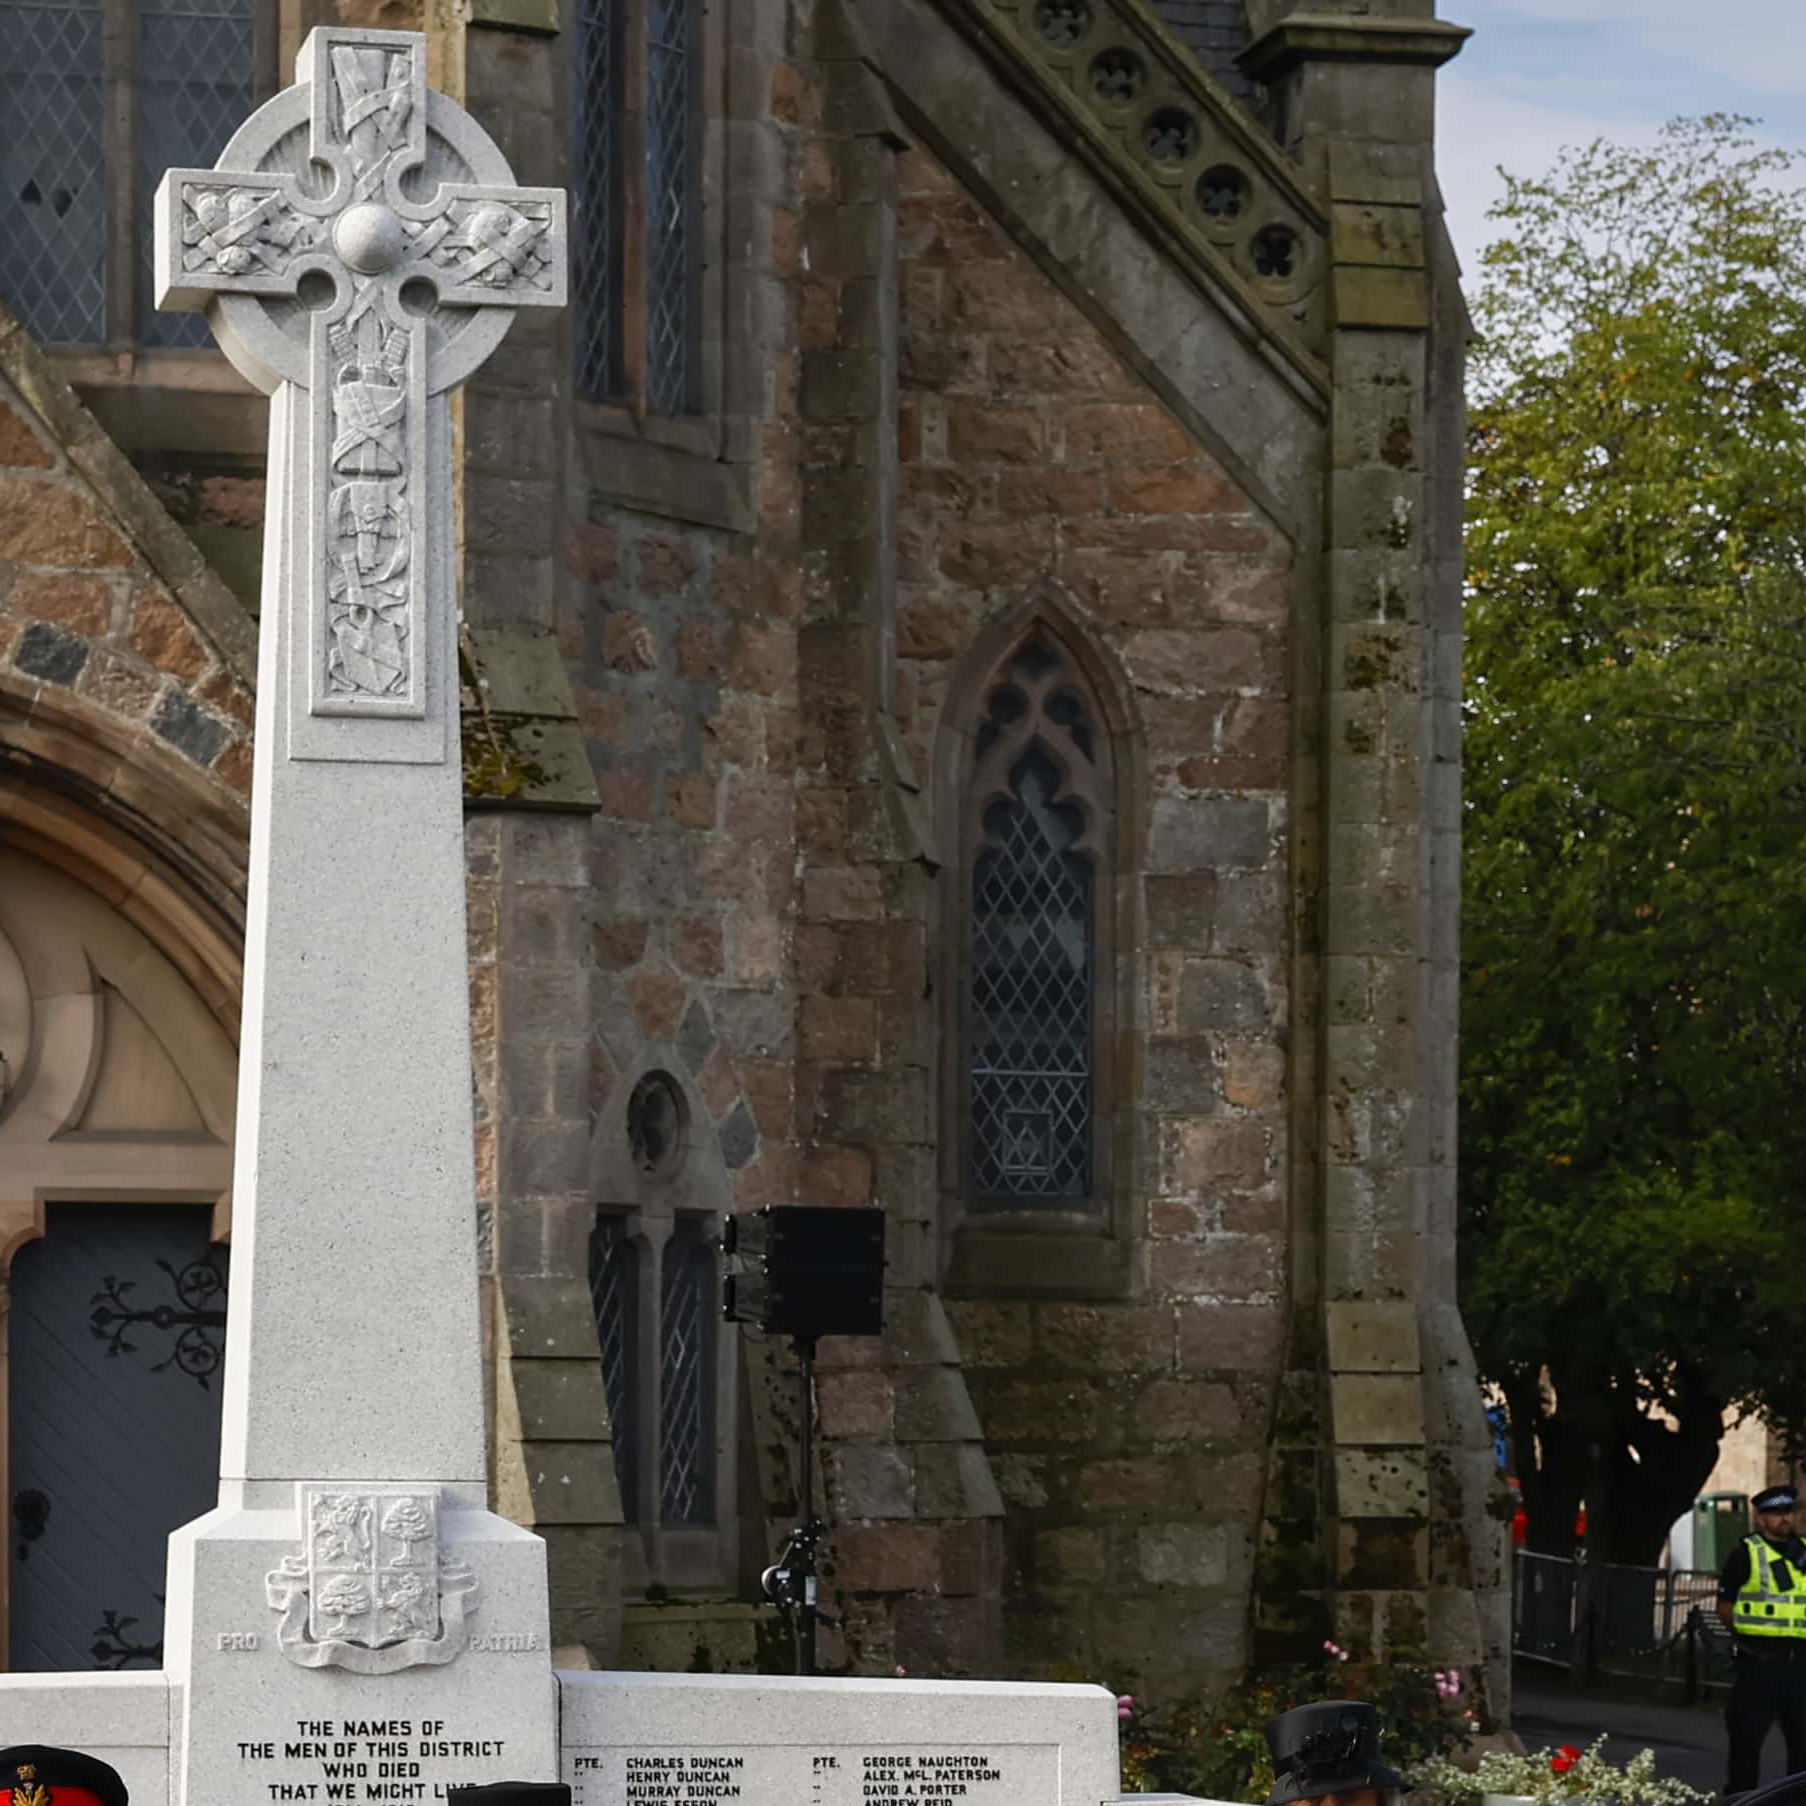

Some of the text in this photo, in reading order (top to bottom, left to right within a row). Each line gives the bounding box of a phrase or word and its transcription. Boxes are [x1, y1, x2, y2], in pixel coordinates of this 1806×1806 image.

[218, 1633, 541, 1651] PRO PATRIA
[297, 1721, 443, 1736] THE NAMES OF
[238, 1742, 504, 1758] THE MEN OF THIS DISTRICT
[627, 1758, 684, 1768] CHARLES
[691, 1758, 743, 1768] DUNCAN
[863, 1757, 911, 1767] GEORGE
[919, 1757, 987, 1767] NAUGHTON
[323, 1763, 419, 1777] WHO DIED
[936, 1770, 1000, 1780] PATERSON
[627, 1771, 729, 1782] HENRY DUNCAN
[269, 1785, 318, 1799] THAT
[326, 1784, 355, 1799] WE
[367, 1784, 425, 1799] MIGHT
[627, 1786, 739, 1797] MURRAY DUNCAN
[864, 1785, 898, 1795] DAVID
[920, 1785, 966, 1795] PORTER
